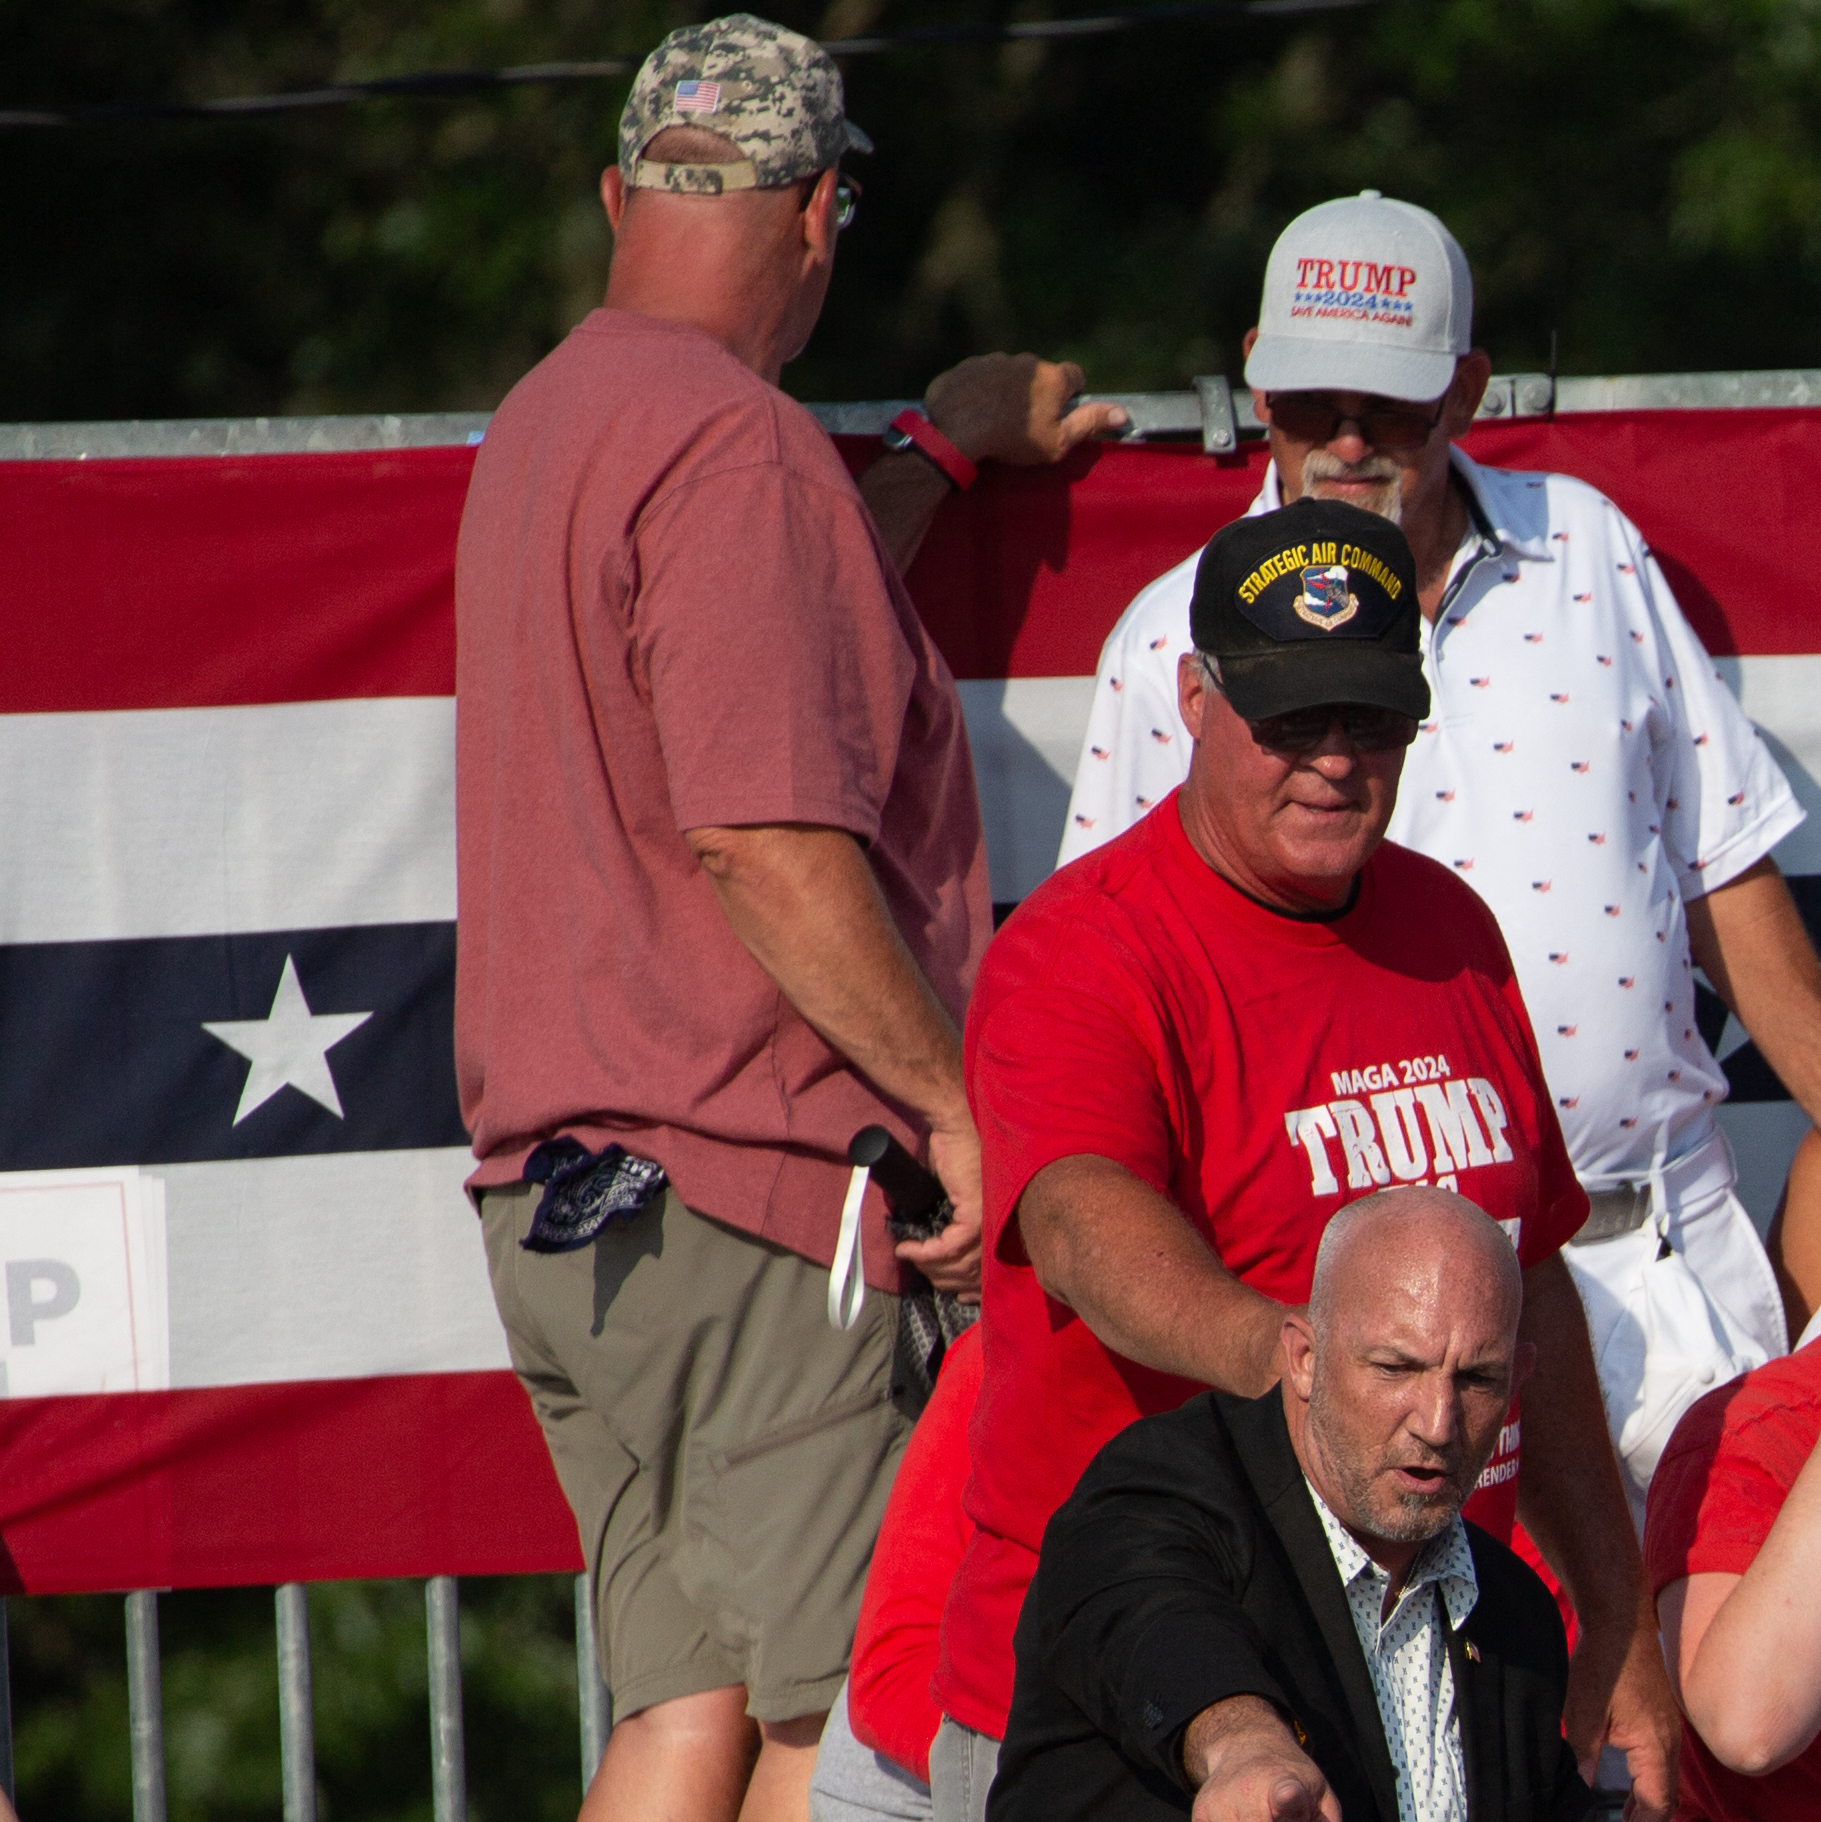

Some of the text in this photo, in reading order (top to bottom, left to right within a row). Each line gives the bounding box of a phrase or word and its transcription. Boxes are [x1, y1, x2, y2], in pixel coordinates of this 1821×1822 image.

[1296, 257, 1417, 298] TRUMP
[1323, 291, 1377, 310] 2024
[1238, 541, 1402, 605] STRATEGIC AIR COMMAND
[1331, 1054, 1450, 1096] MAGA 2024
[1284, 1077, 1514, 1197] TRUMP
